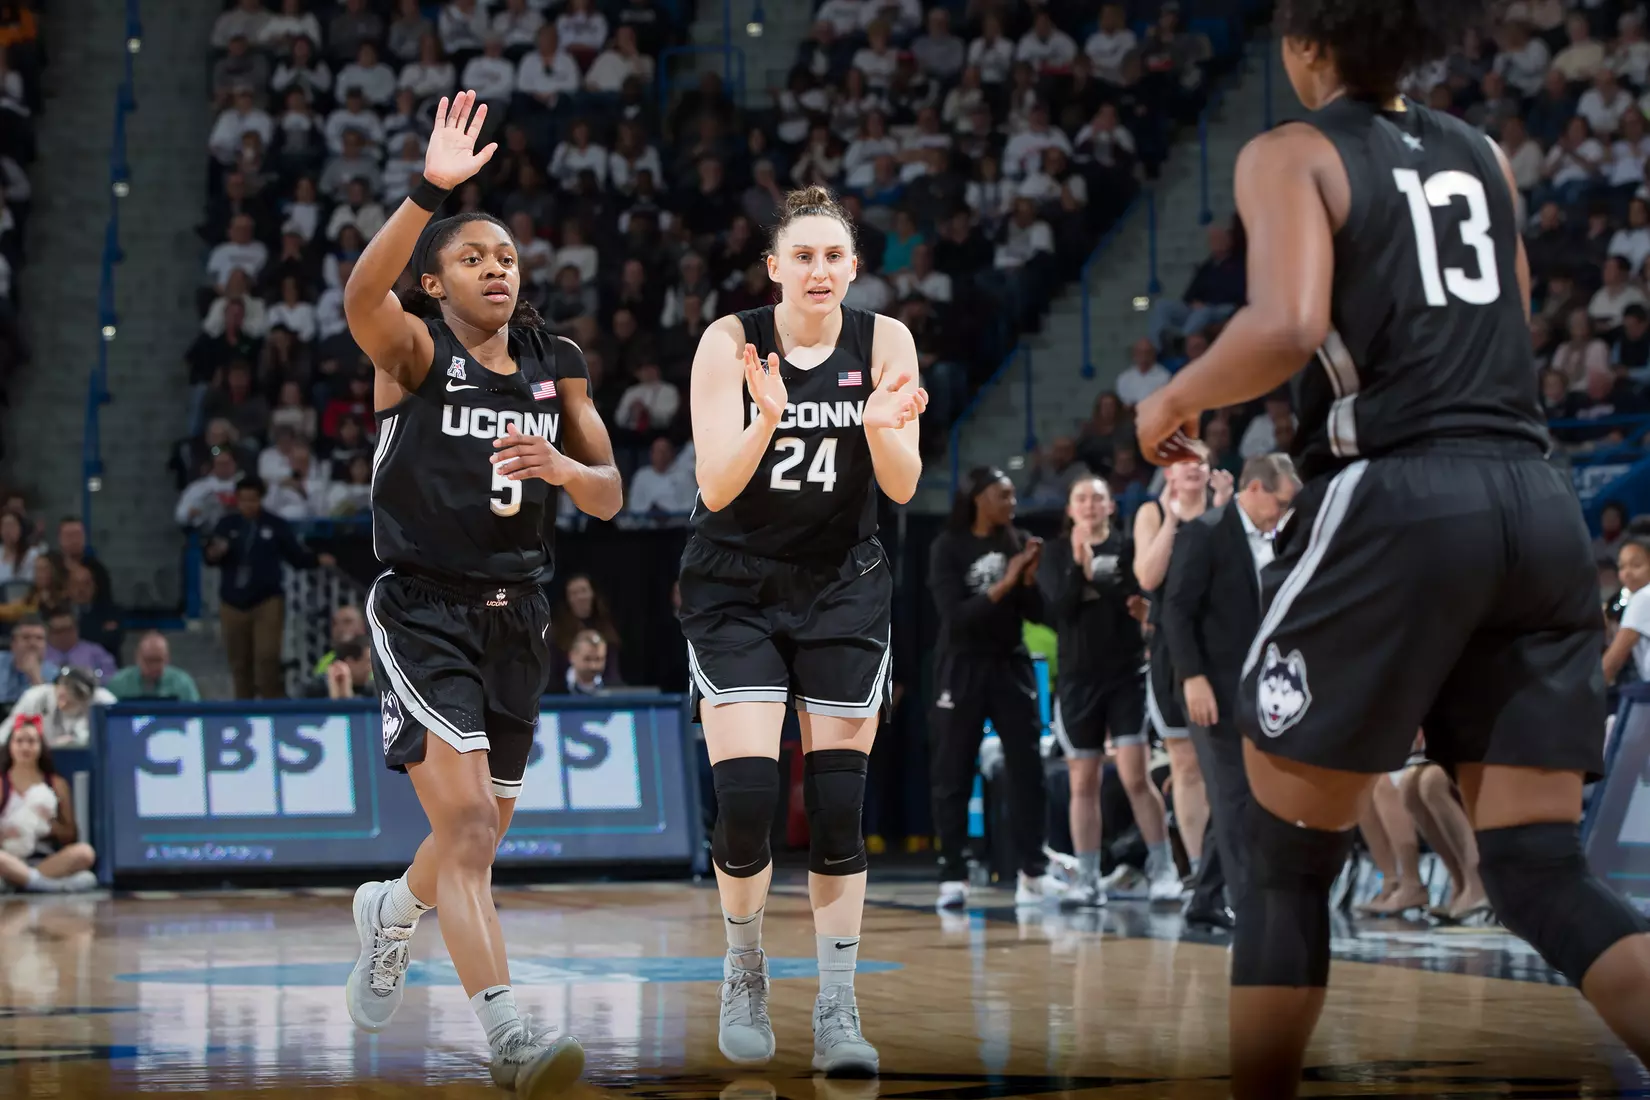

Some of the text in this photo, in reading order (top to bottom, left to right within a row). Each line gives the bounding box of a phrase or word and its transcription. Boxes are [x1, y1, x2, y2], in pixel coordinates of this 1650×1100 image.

[1392, 167, 1500, 306] 13
[441, 404, 560, 443] UCONN
[489, 452, 523, 517] 5
[769, 436, 838, 492] 24
[135, 715, 327, 776] CBS
